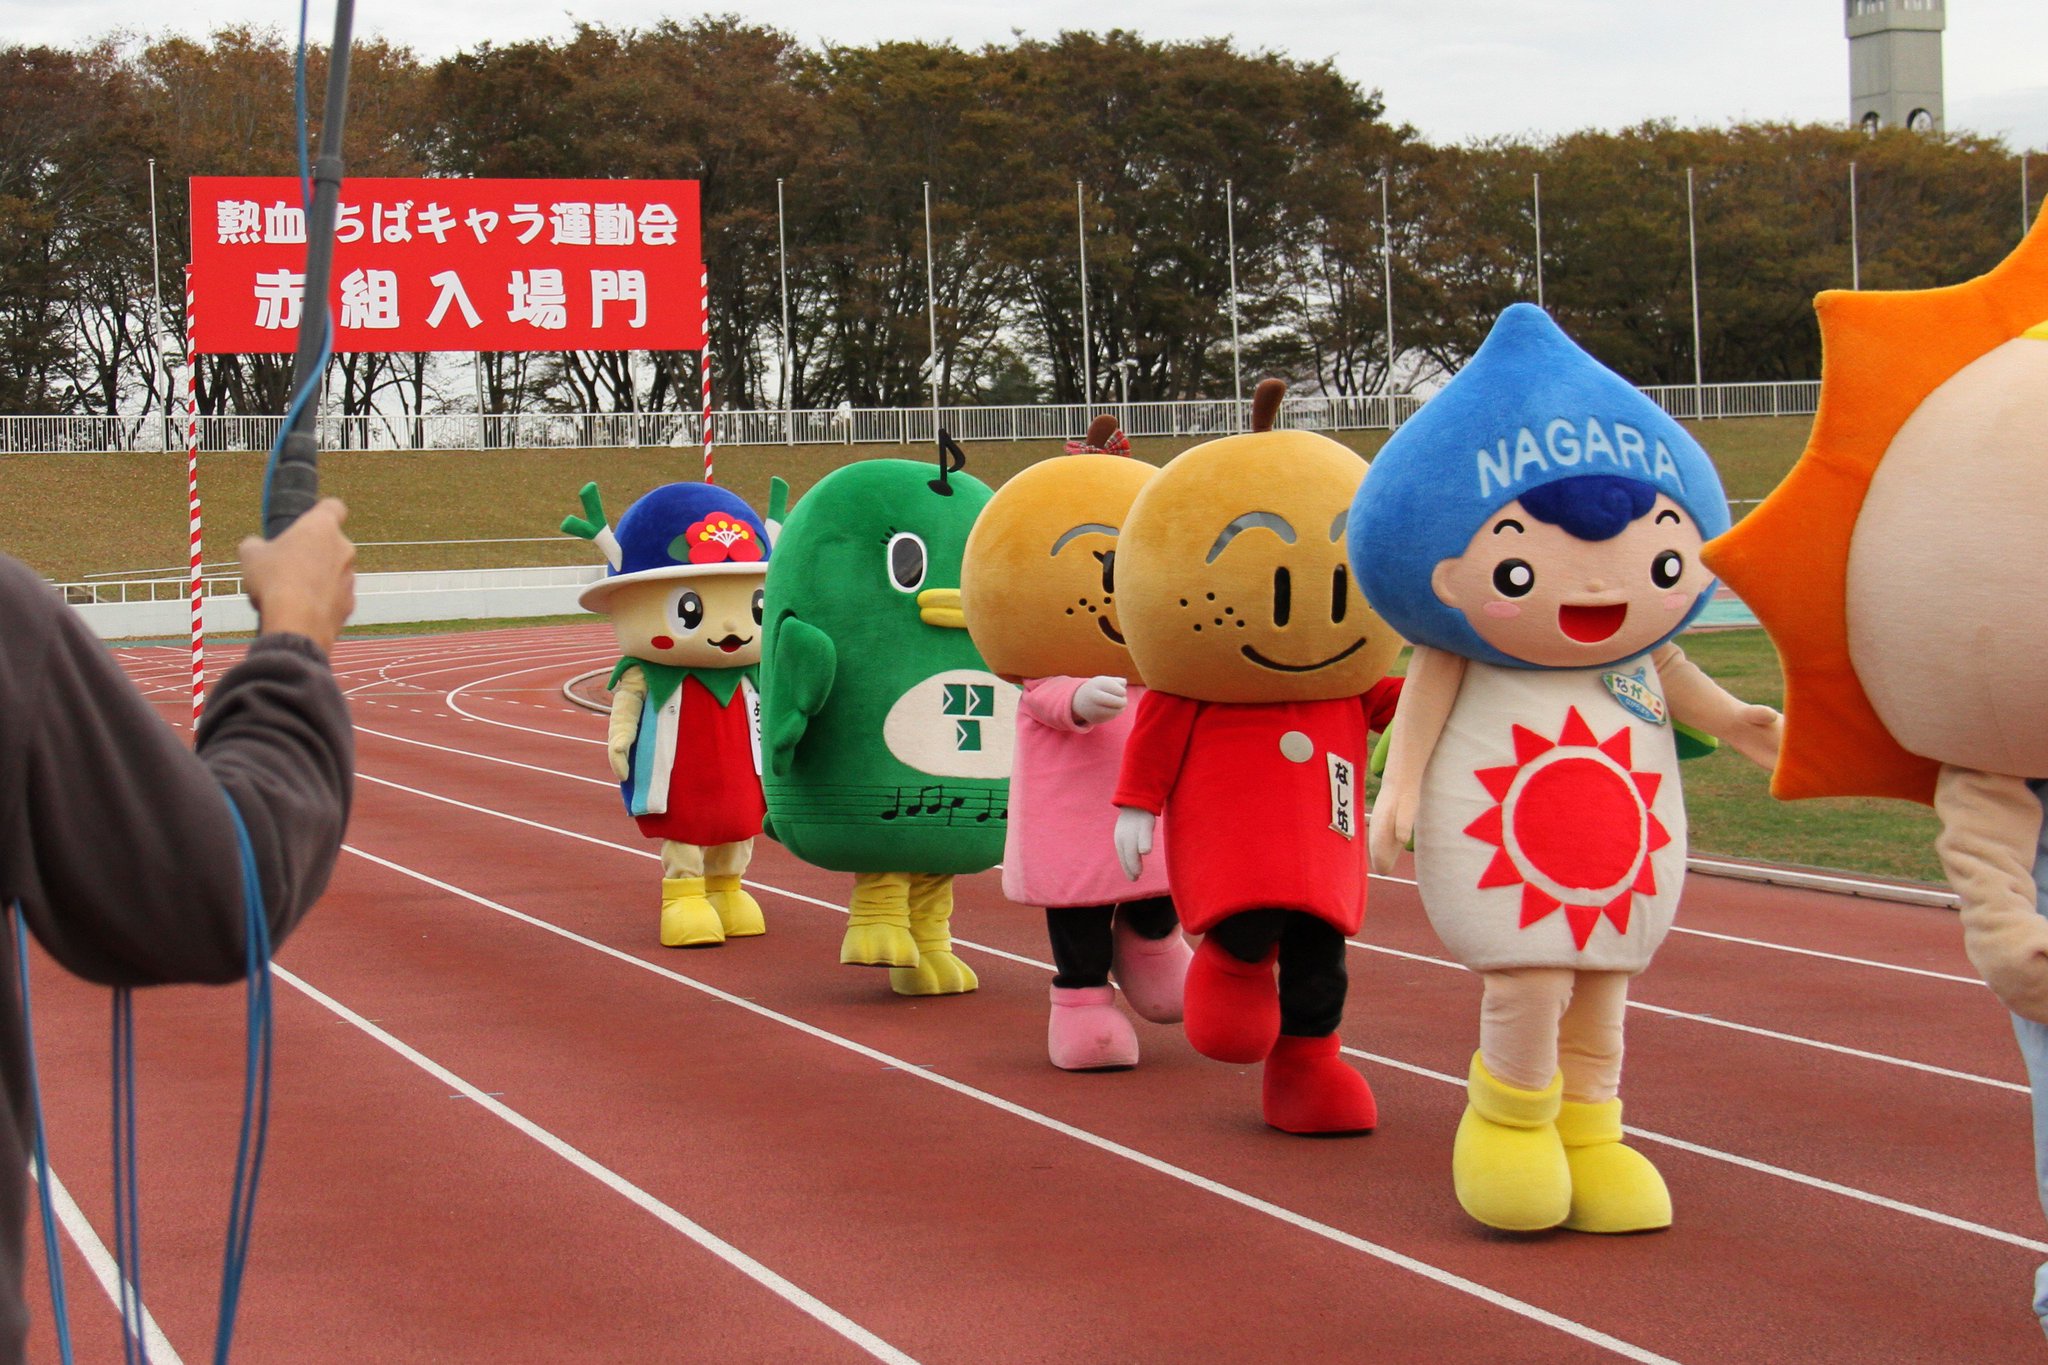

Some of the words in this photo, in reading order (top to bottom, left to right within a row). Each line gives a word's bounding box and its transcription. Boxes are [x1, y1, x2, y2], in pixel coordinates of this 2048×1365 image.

[216, 200, 678, 246] 熱血ちばキャラ運動会
[254, 268, 647, 330] 赤組入場門
[1476, 416, 1686, 498] NAGARA
[1335, 762, 1349, 833] なし坊
